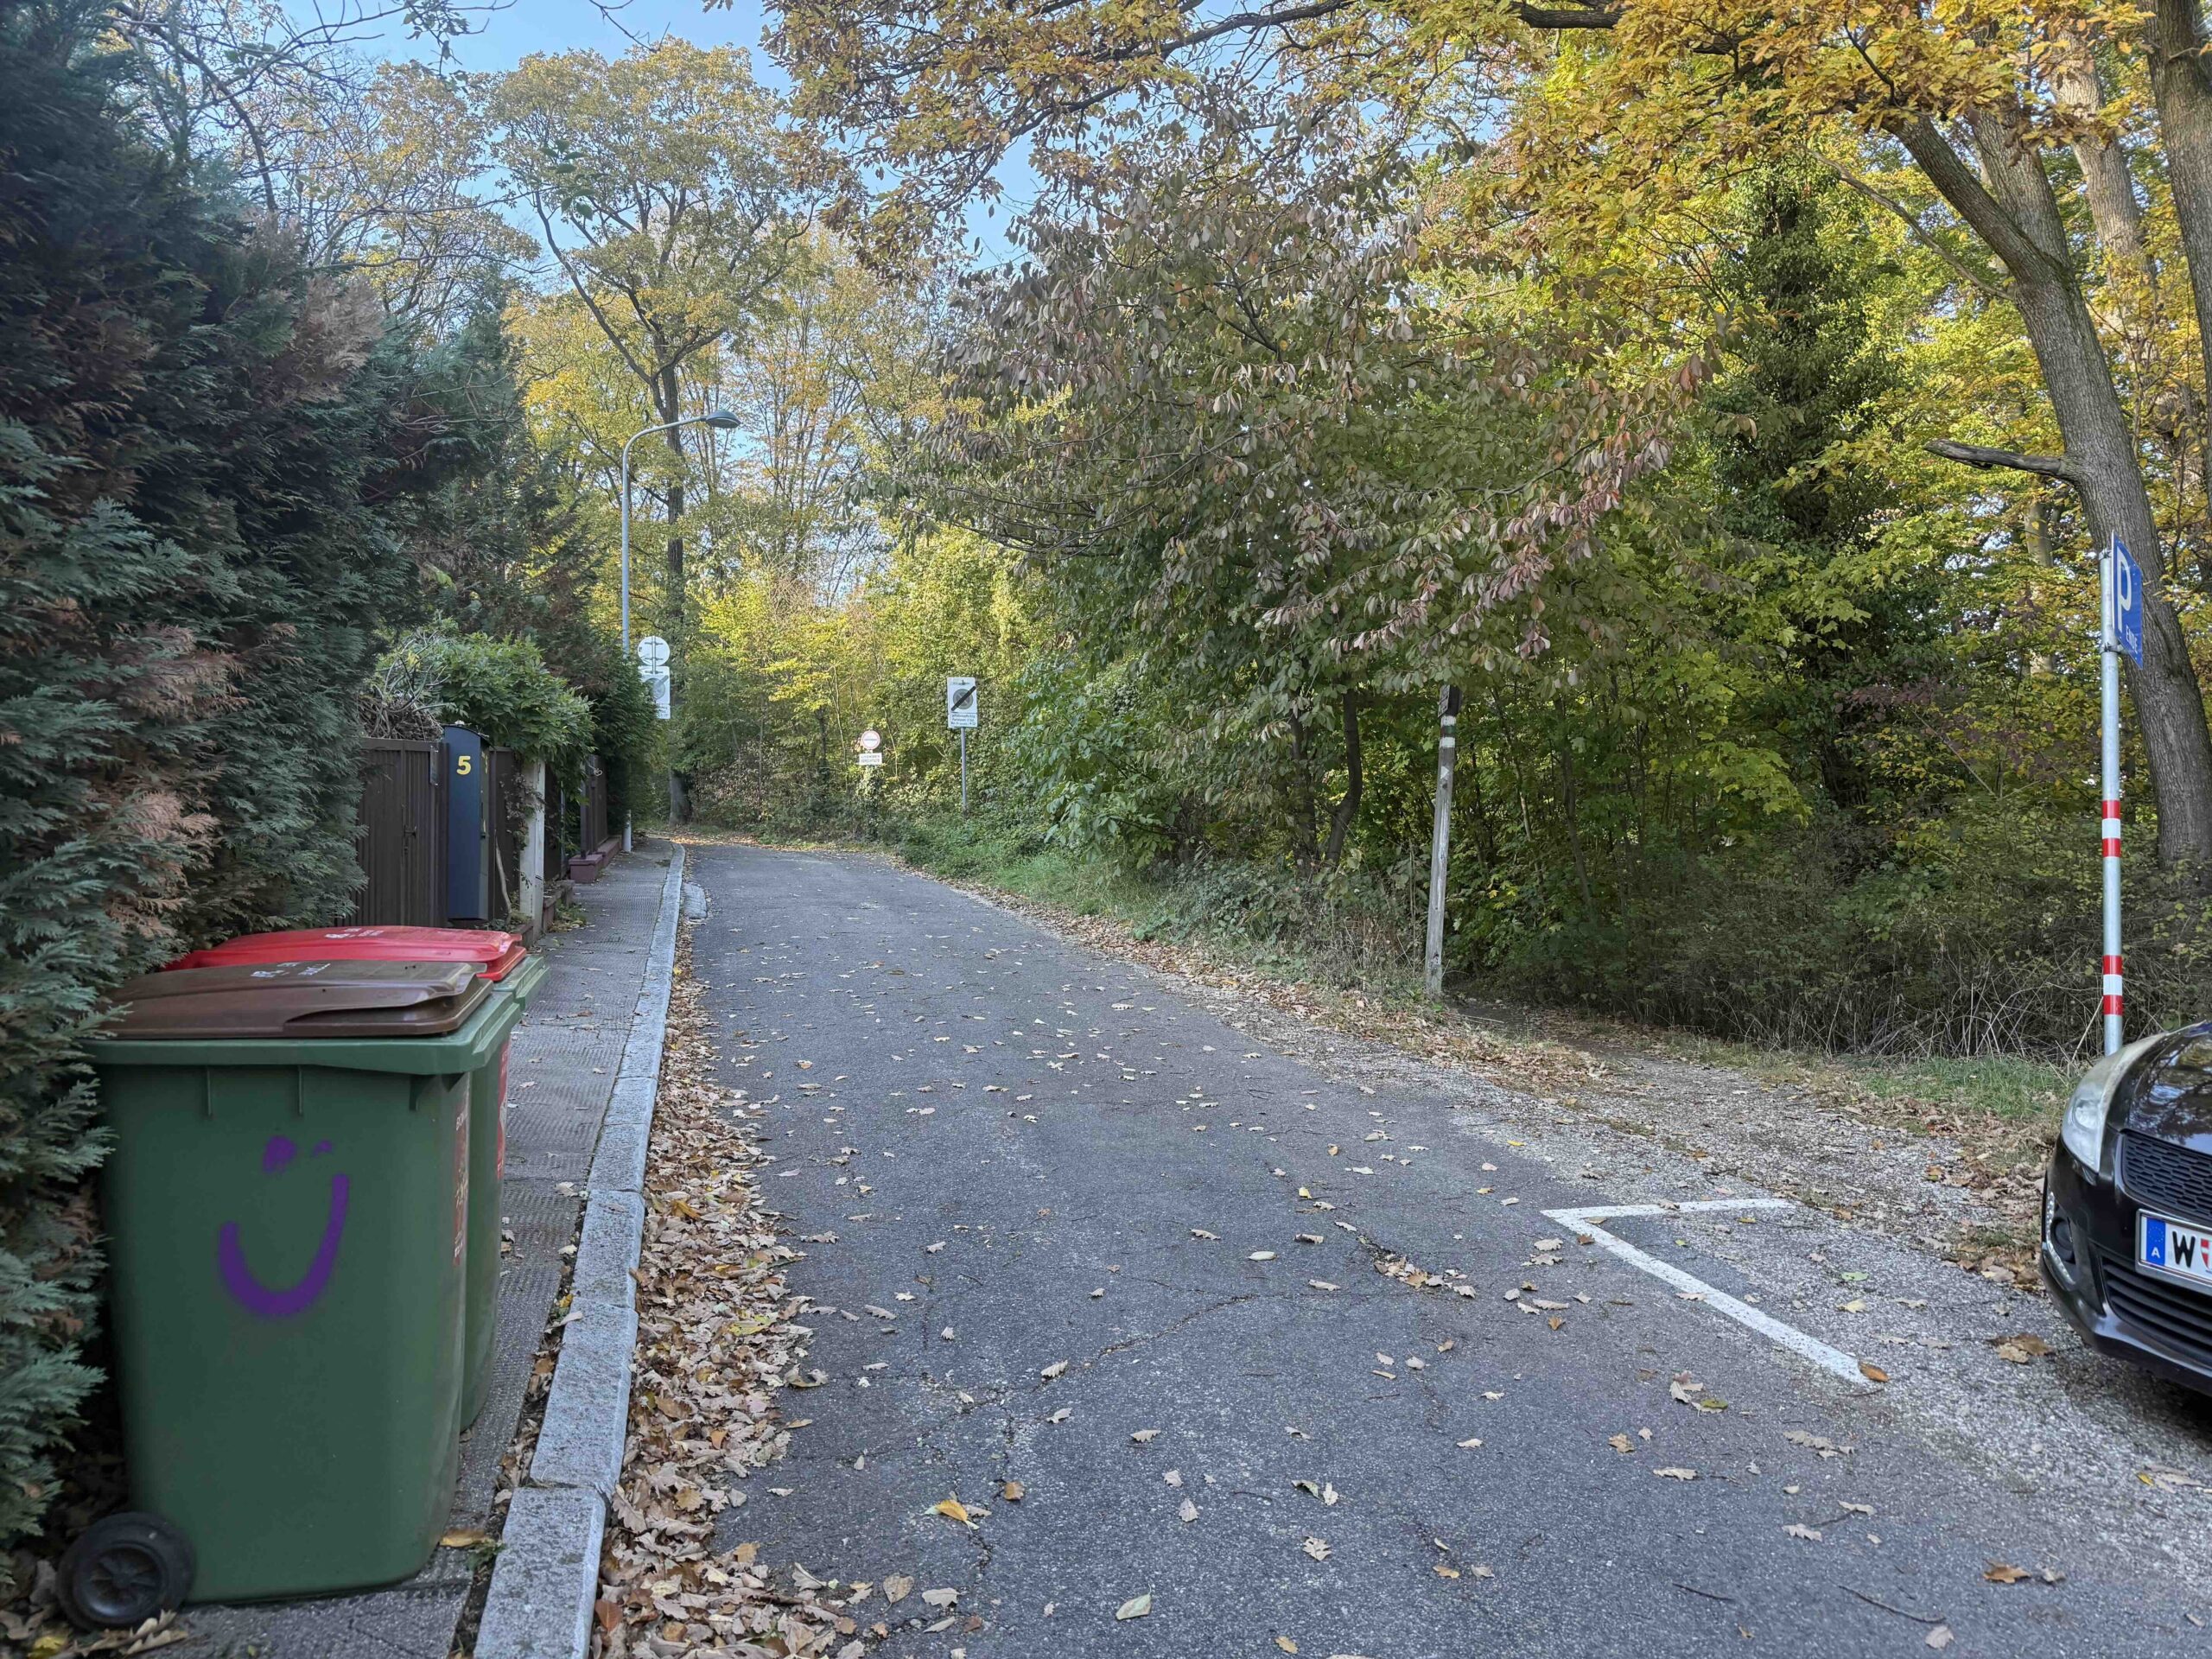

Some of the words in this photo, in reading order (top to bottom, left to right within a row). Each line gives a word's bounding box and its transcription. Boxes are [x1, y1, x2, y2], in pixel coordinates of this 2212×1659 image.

[2117, 545, 2132, 633] P
[456, 755, 472, 775] 5
[2152, 1248, 2160, 1258] A
[2172, 1230, 2196, 1268] W
